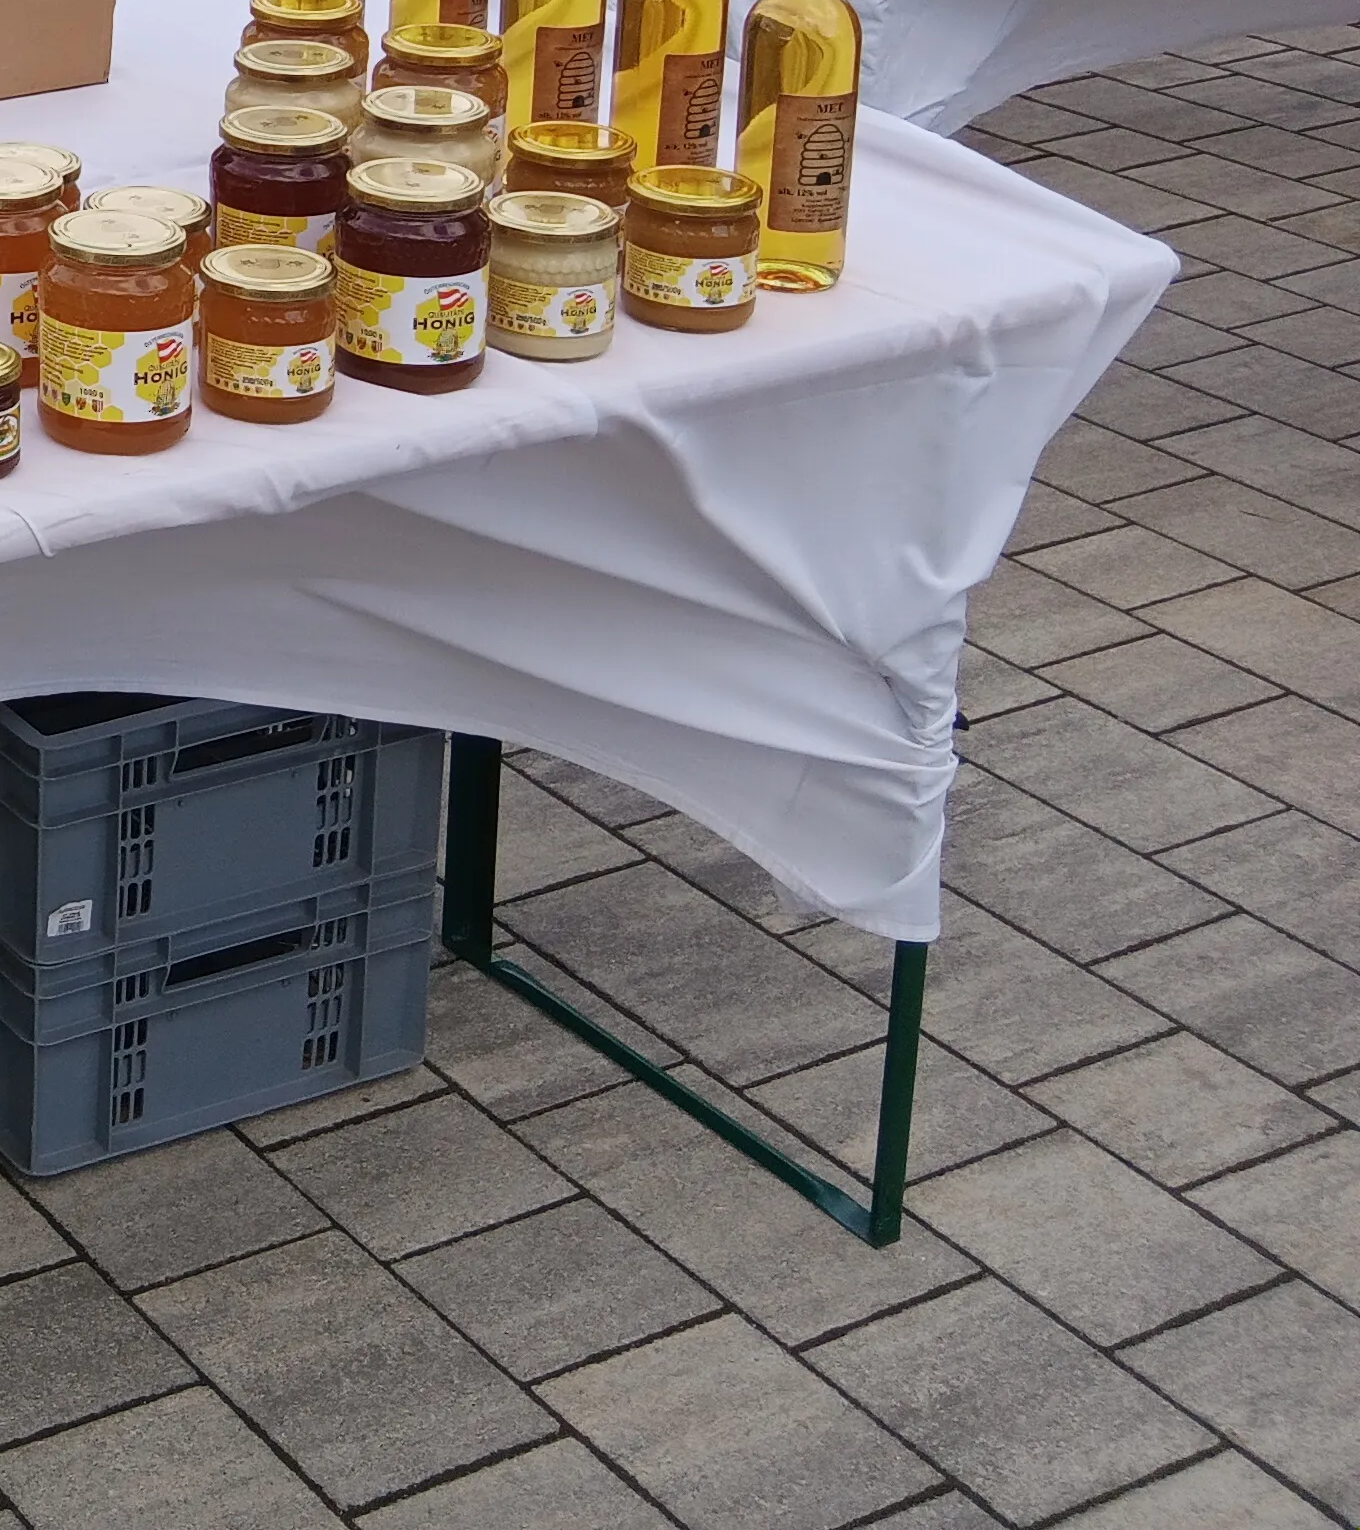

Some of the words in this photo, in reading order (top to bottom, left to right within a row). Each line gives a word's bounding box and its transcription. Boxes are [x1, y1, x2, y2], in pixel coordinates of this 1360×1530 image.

[817, 102, 844, 114] MET
[413, 311, 475, 331] HONIG
[134, 361, 188, 386] HONIG
